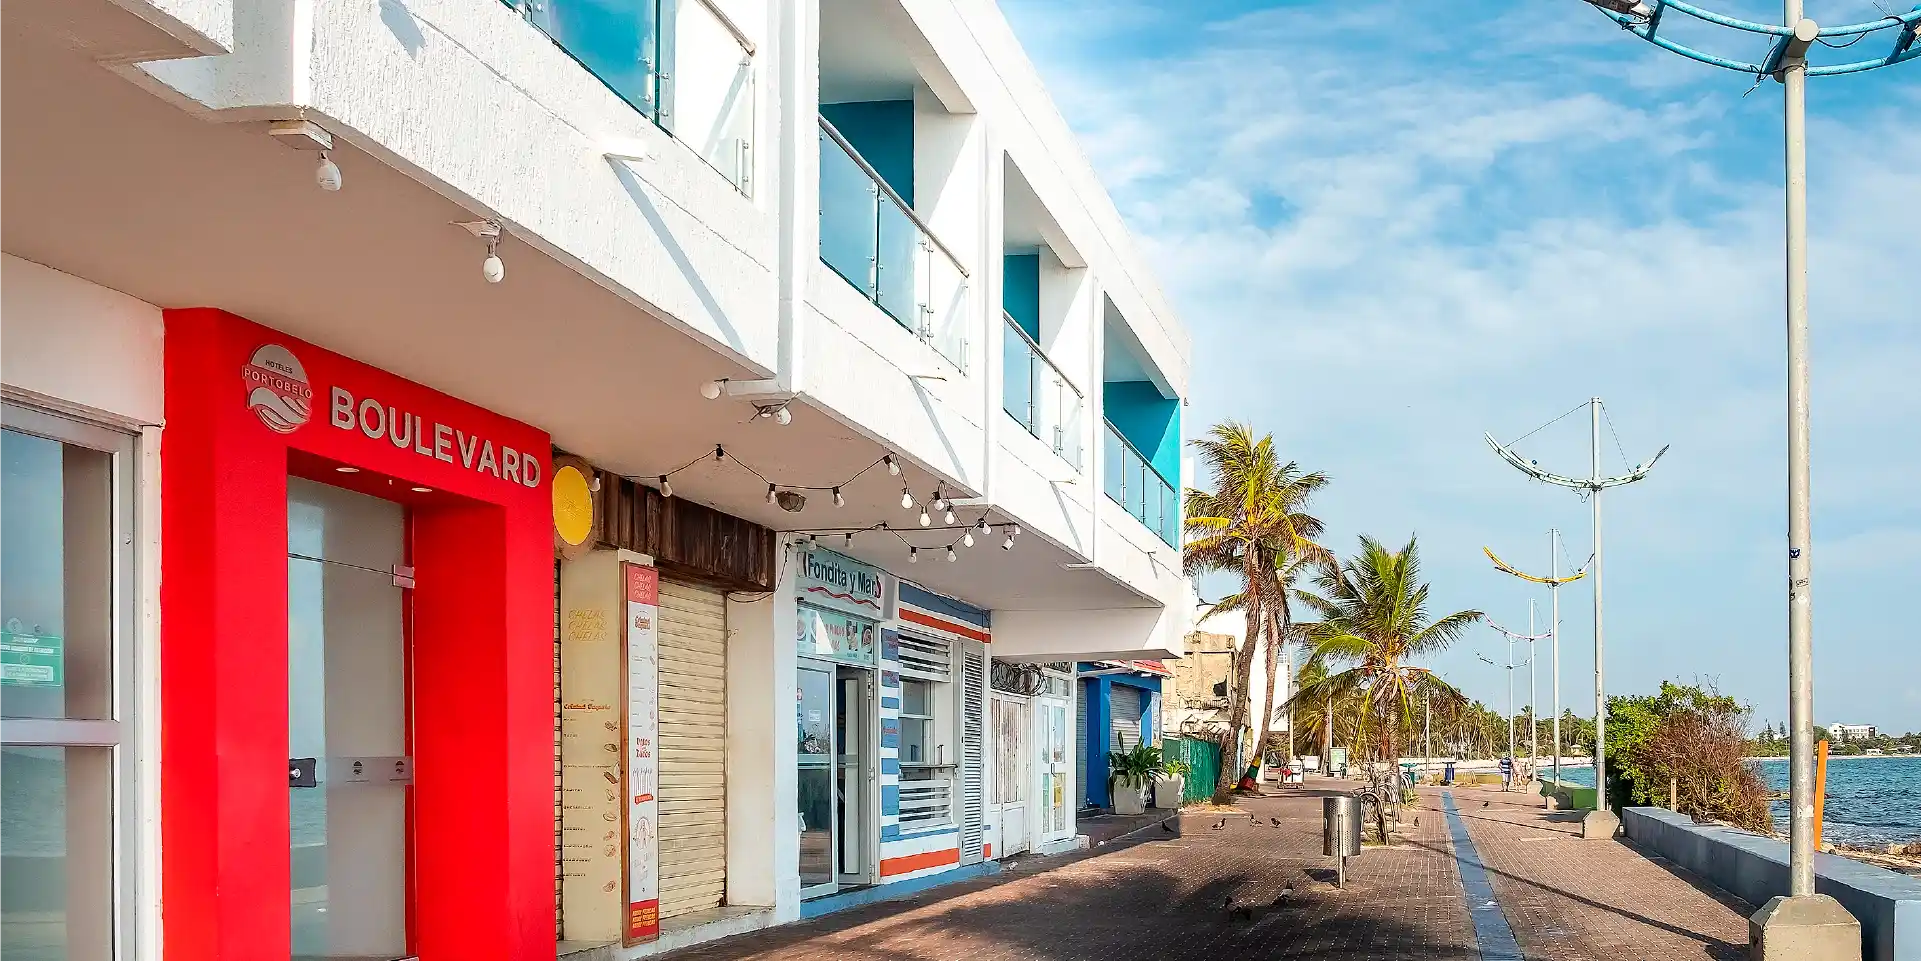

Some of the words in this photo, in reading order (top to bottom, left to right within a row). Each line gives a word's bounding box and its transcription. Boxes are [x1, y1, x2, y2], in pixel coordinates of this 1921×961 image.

[244, 367, 312, 399] PORTOBELO
[265, 359, 293, 374] HOTELES
[331, 385, 541, 488] BOULEVARD
[807, 553, 847, 587] Fondita
[849, 573, 856, 594] y
